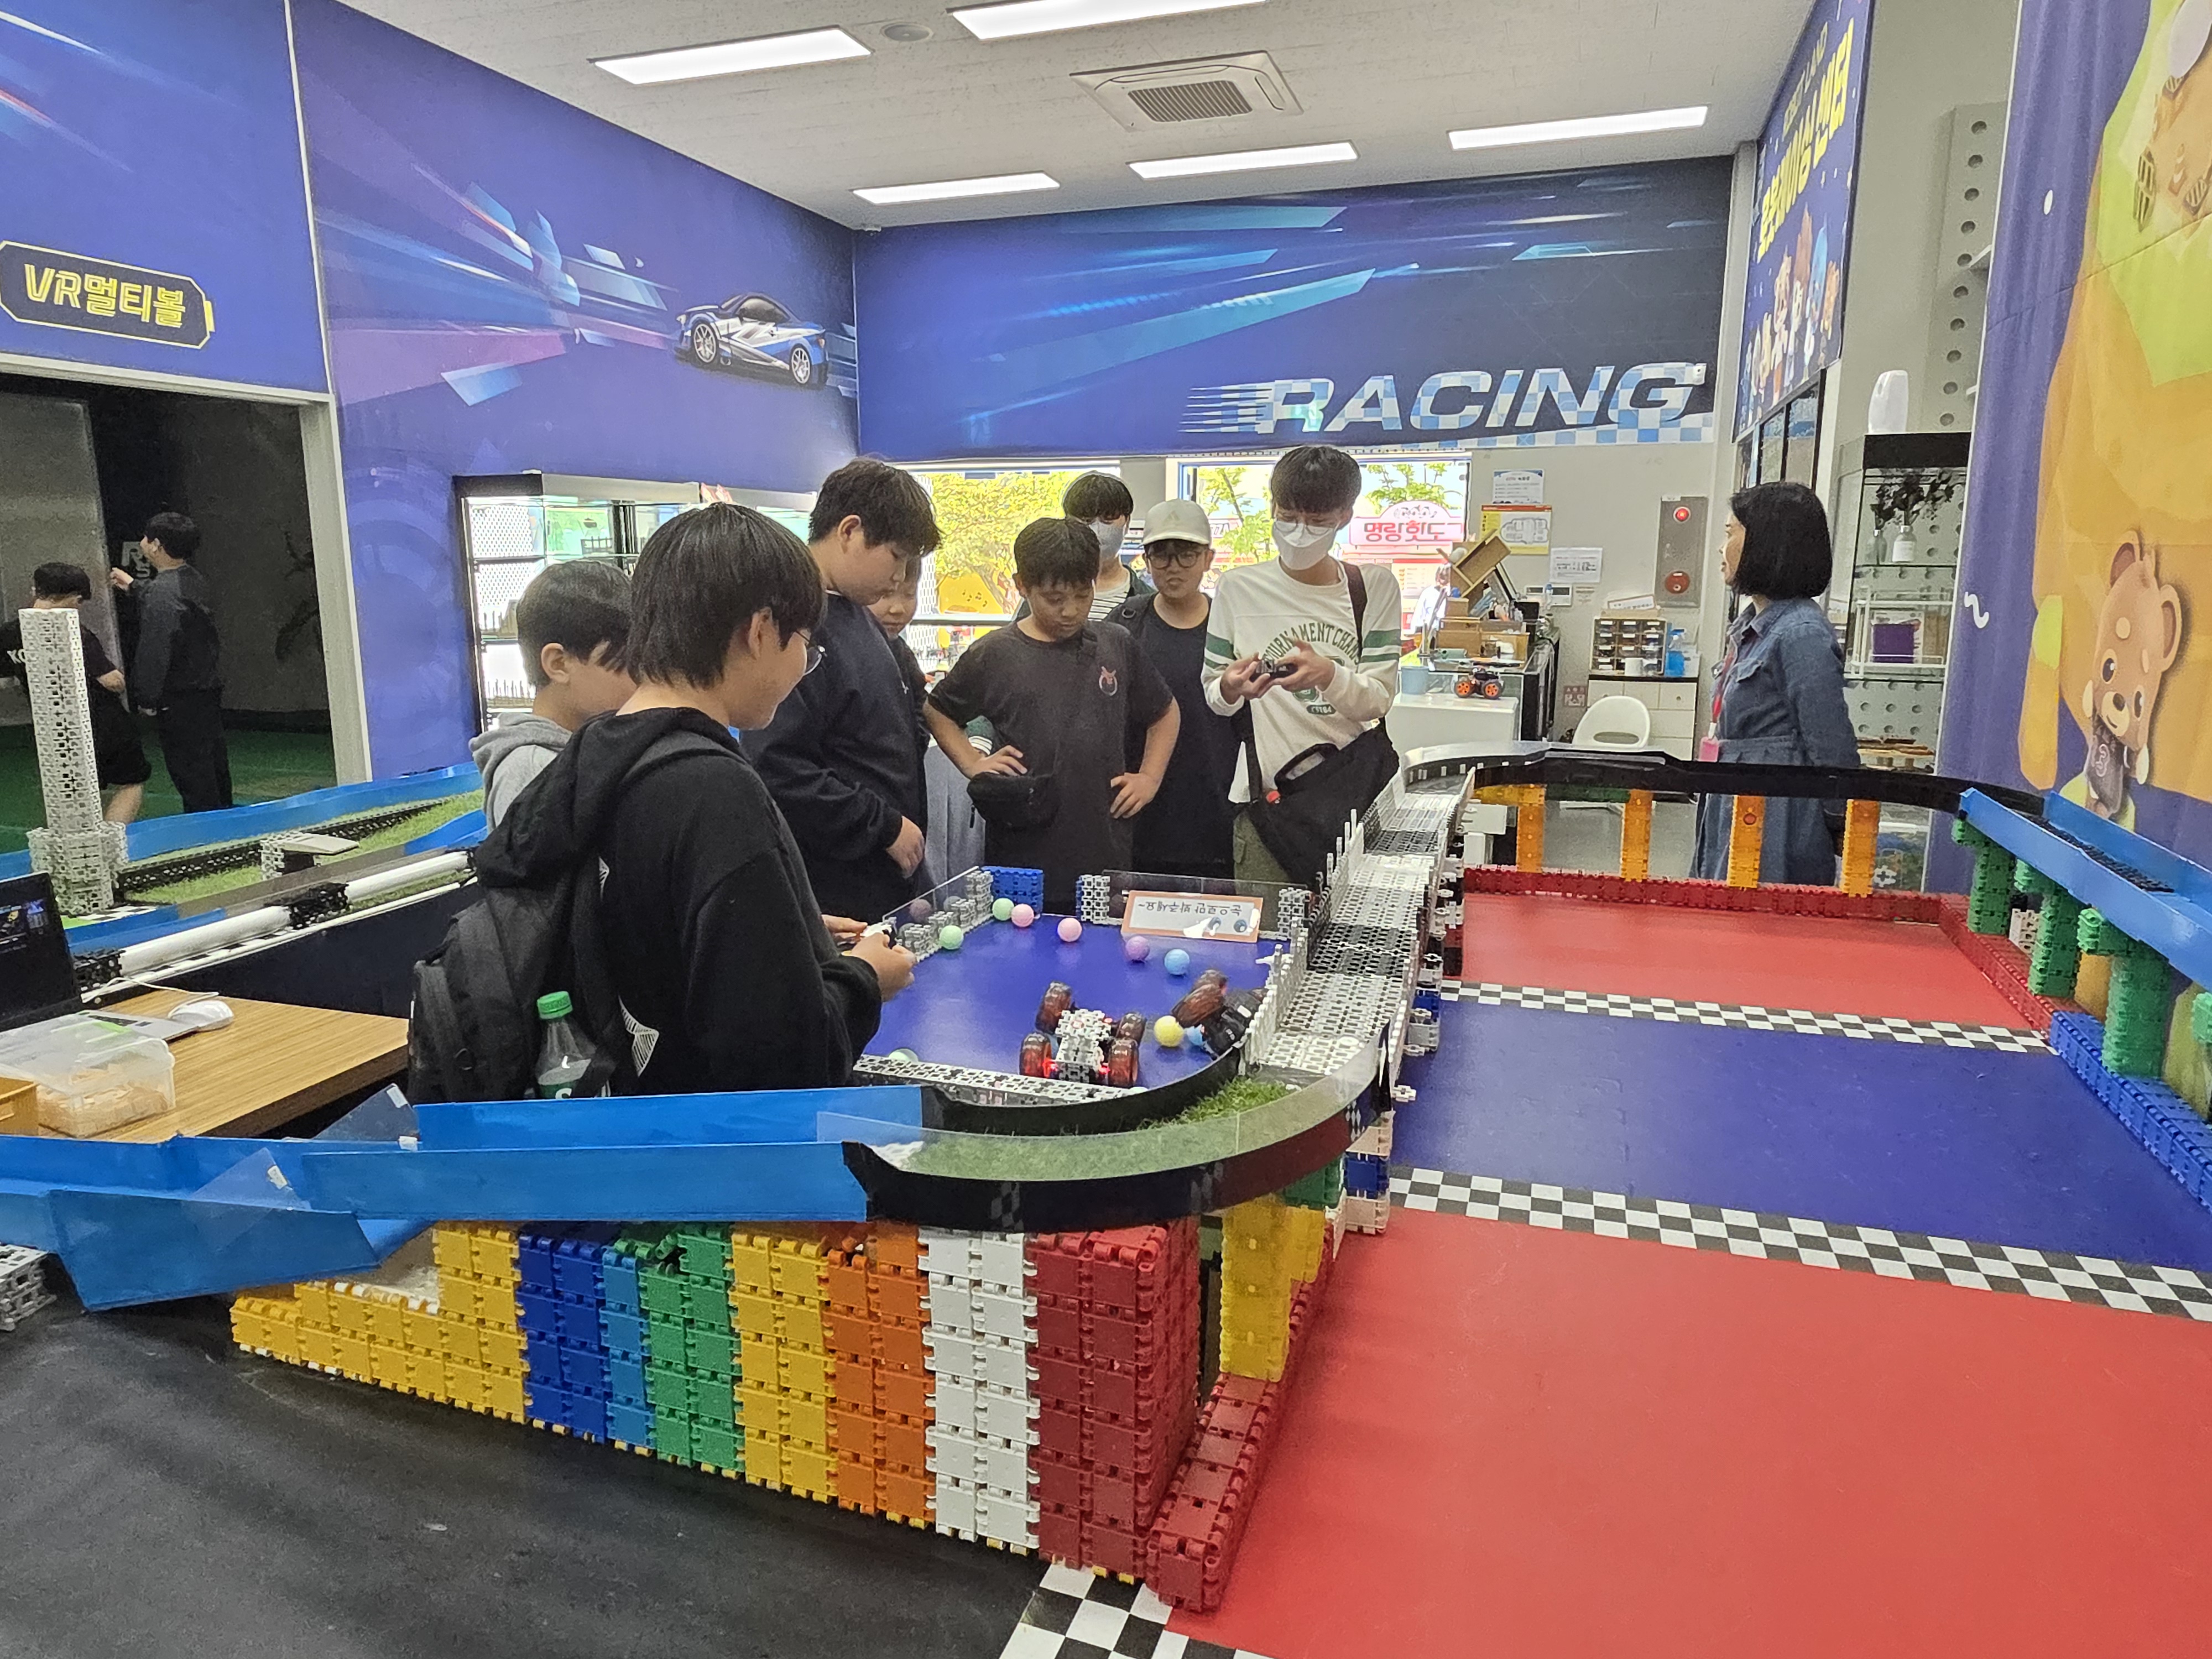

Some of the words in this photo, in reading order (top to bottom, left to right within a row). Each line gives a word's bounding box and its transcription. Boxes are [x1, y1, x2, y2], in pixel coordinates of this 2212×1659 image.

[24, 264, 186, 327] VR멀티볼
[1258, 362, 1706, 434] RACING
[1195, 902, 1242, 916] 눈으로만
